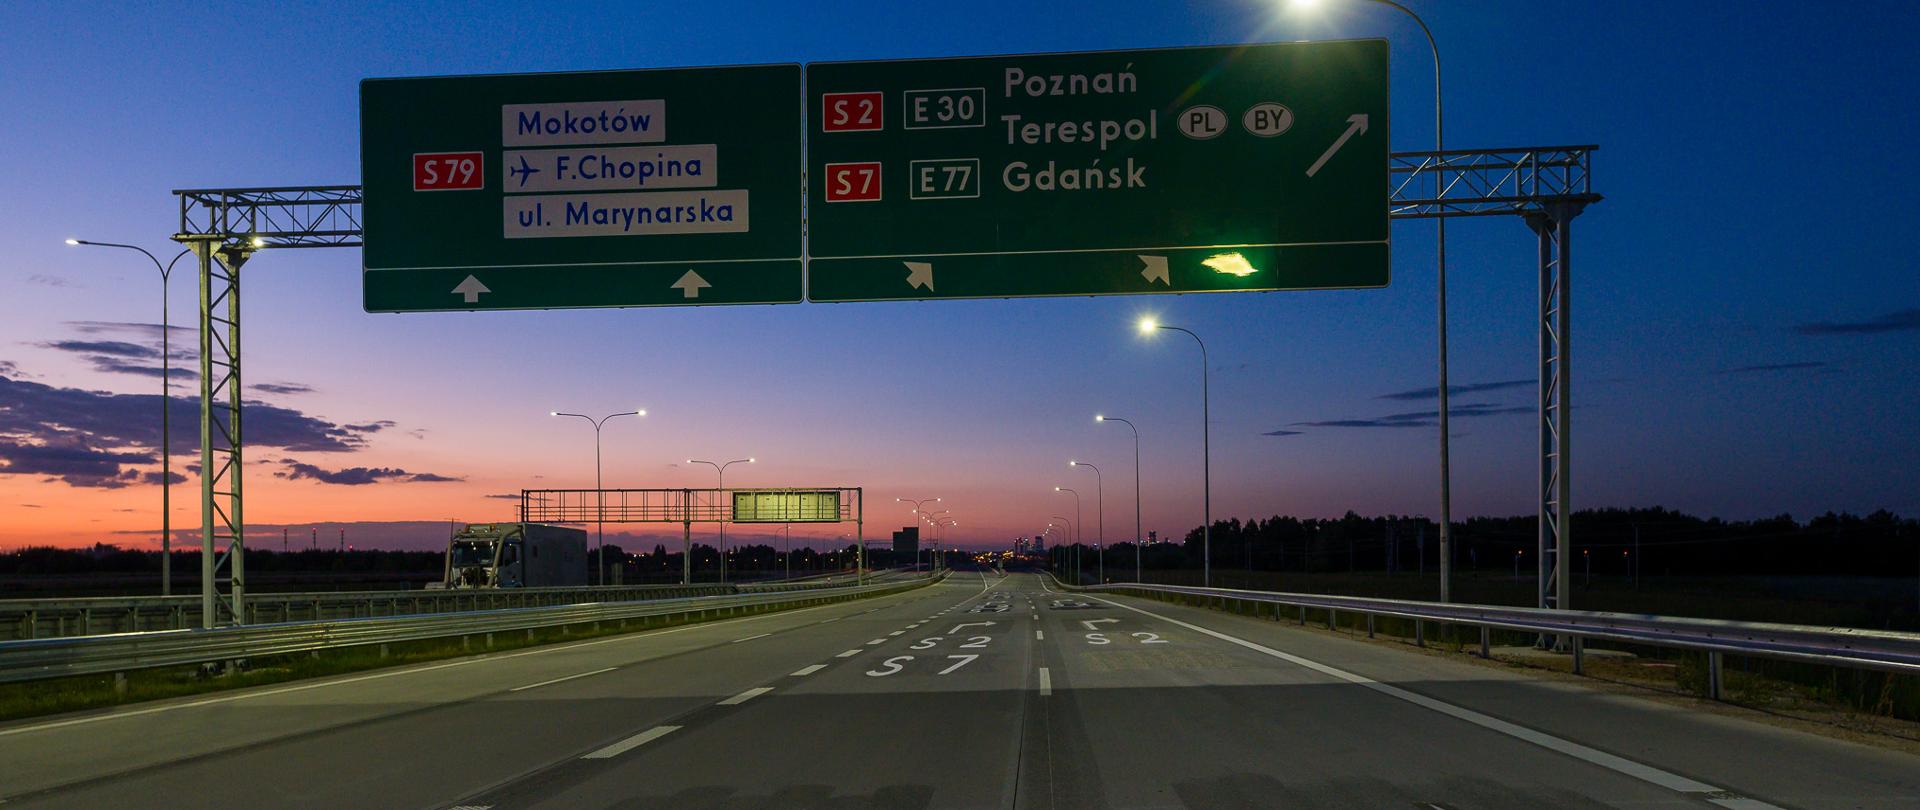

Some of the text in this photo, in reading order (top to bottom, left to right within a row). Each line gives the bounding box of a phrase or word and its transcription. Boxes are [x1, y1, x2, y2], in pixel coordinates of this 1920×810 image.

[1004, 64, 1138, 97] Poznań
[518, 108, 652, 135] Mokotów
[1001, 109, 1158, 150] Terespol
[1189, 112, 1217, 133] PL
[1254, 109, 1284, 131] BY
[556, 153, 702, 185] F.Chopina
[1002, 158, 1146, 192] Gdańsk
[518, 198, 734, 232] ul. Marynarska
